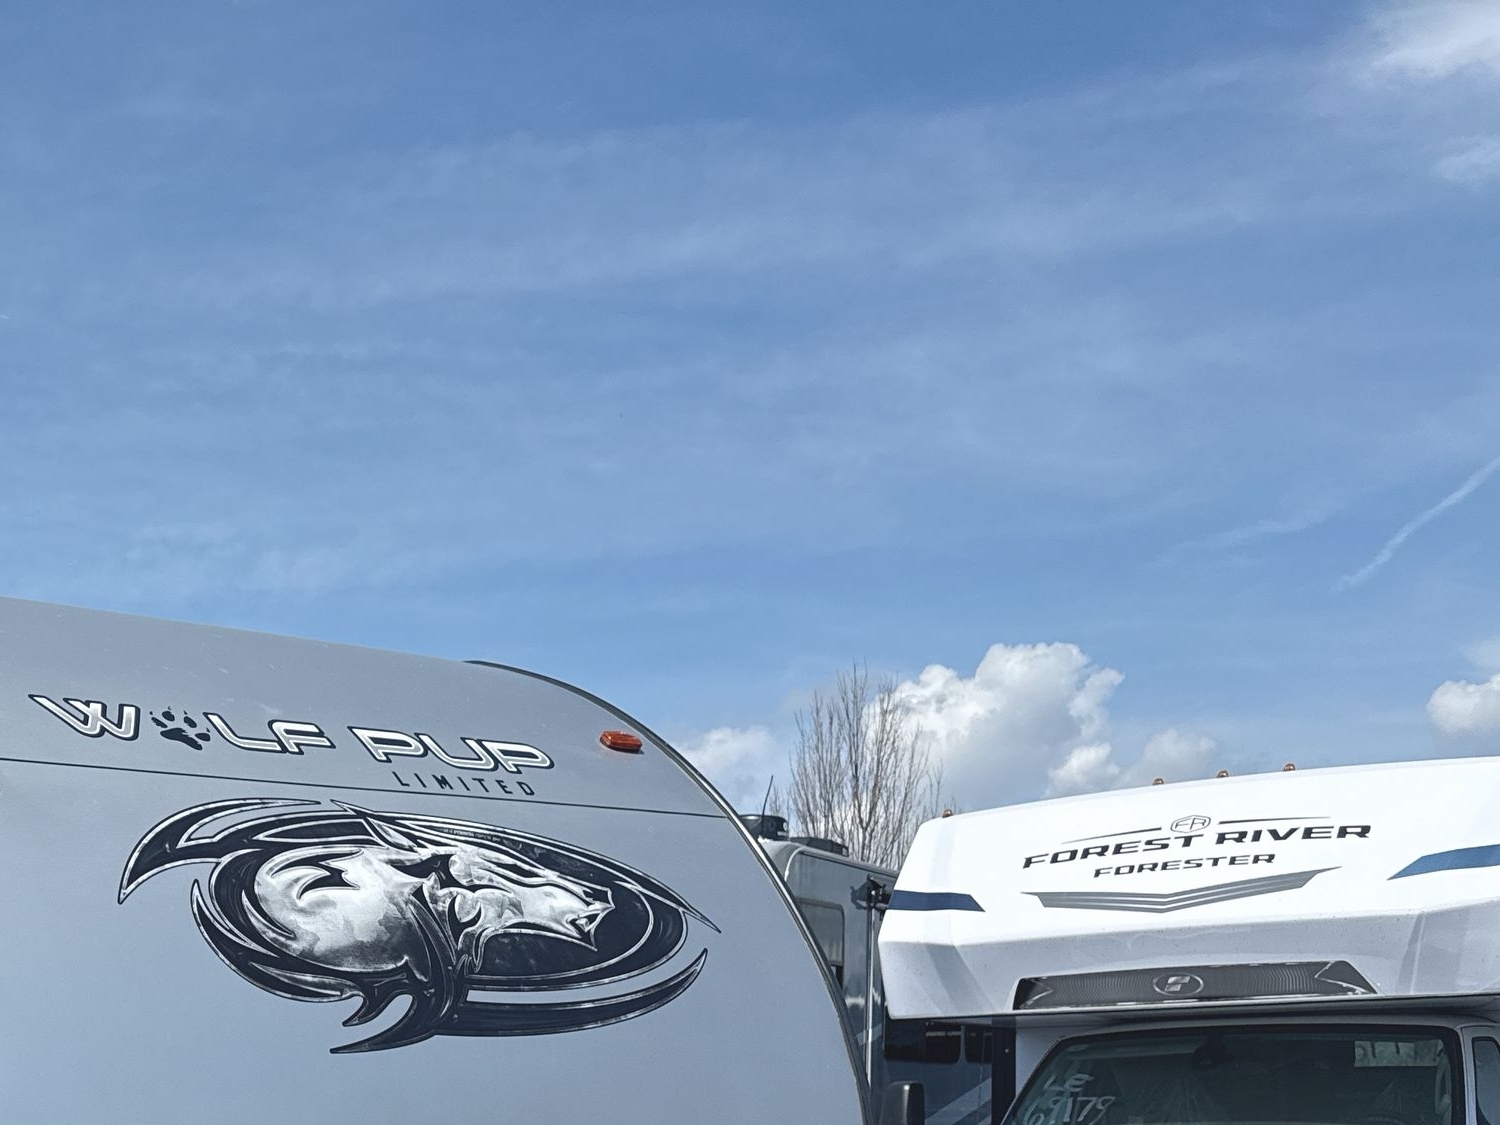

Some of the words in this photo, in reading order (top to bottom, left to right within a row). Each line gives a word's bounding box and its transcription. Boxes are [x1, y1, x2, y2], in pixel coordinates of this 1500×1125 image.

[28, 694, 336, 755] WLF
[348, 725, 555, 774] PUP
[391, 770, 535, 796] LIMITED
[1022, 833, 1204, 869] FOREST
[1215, 825, 1372, 845] RIVER
[1093, 853, 1276, 878] FORESTER
